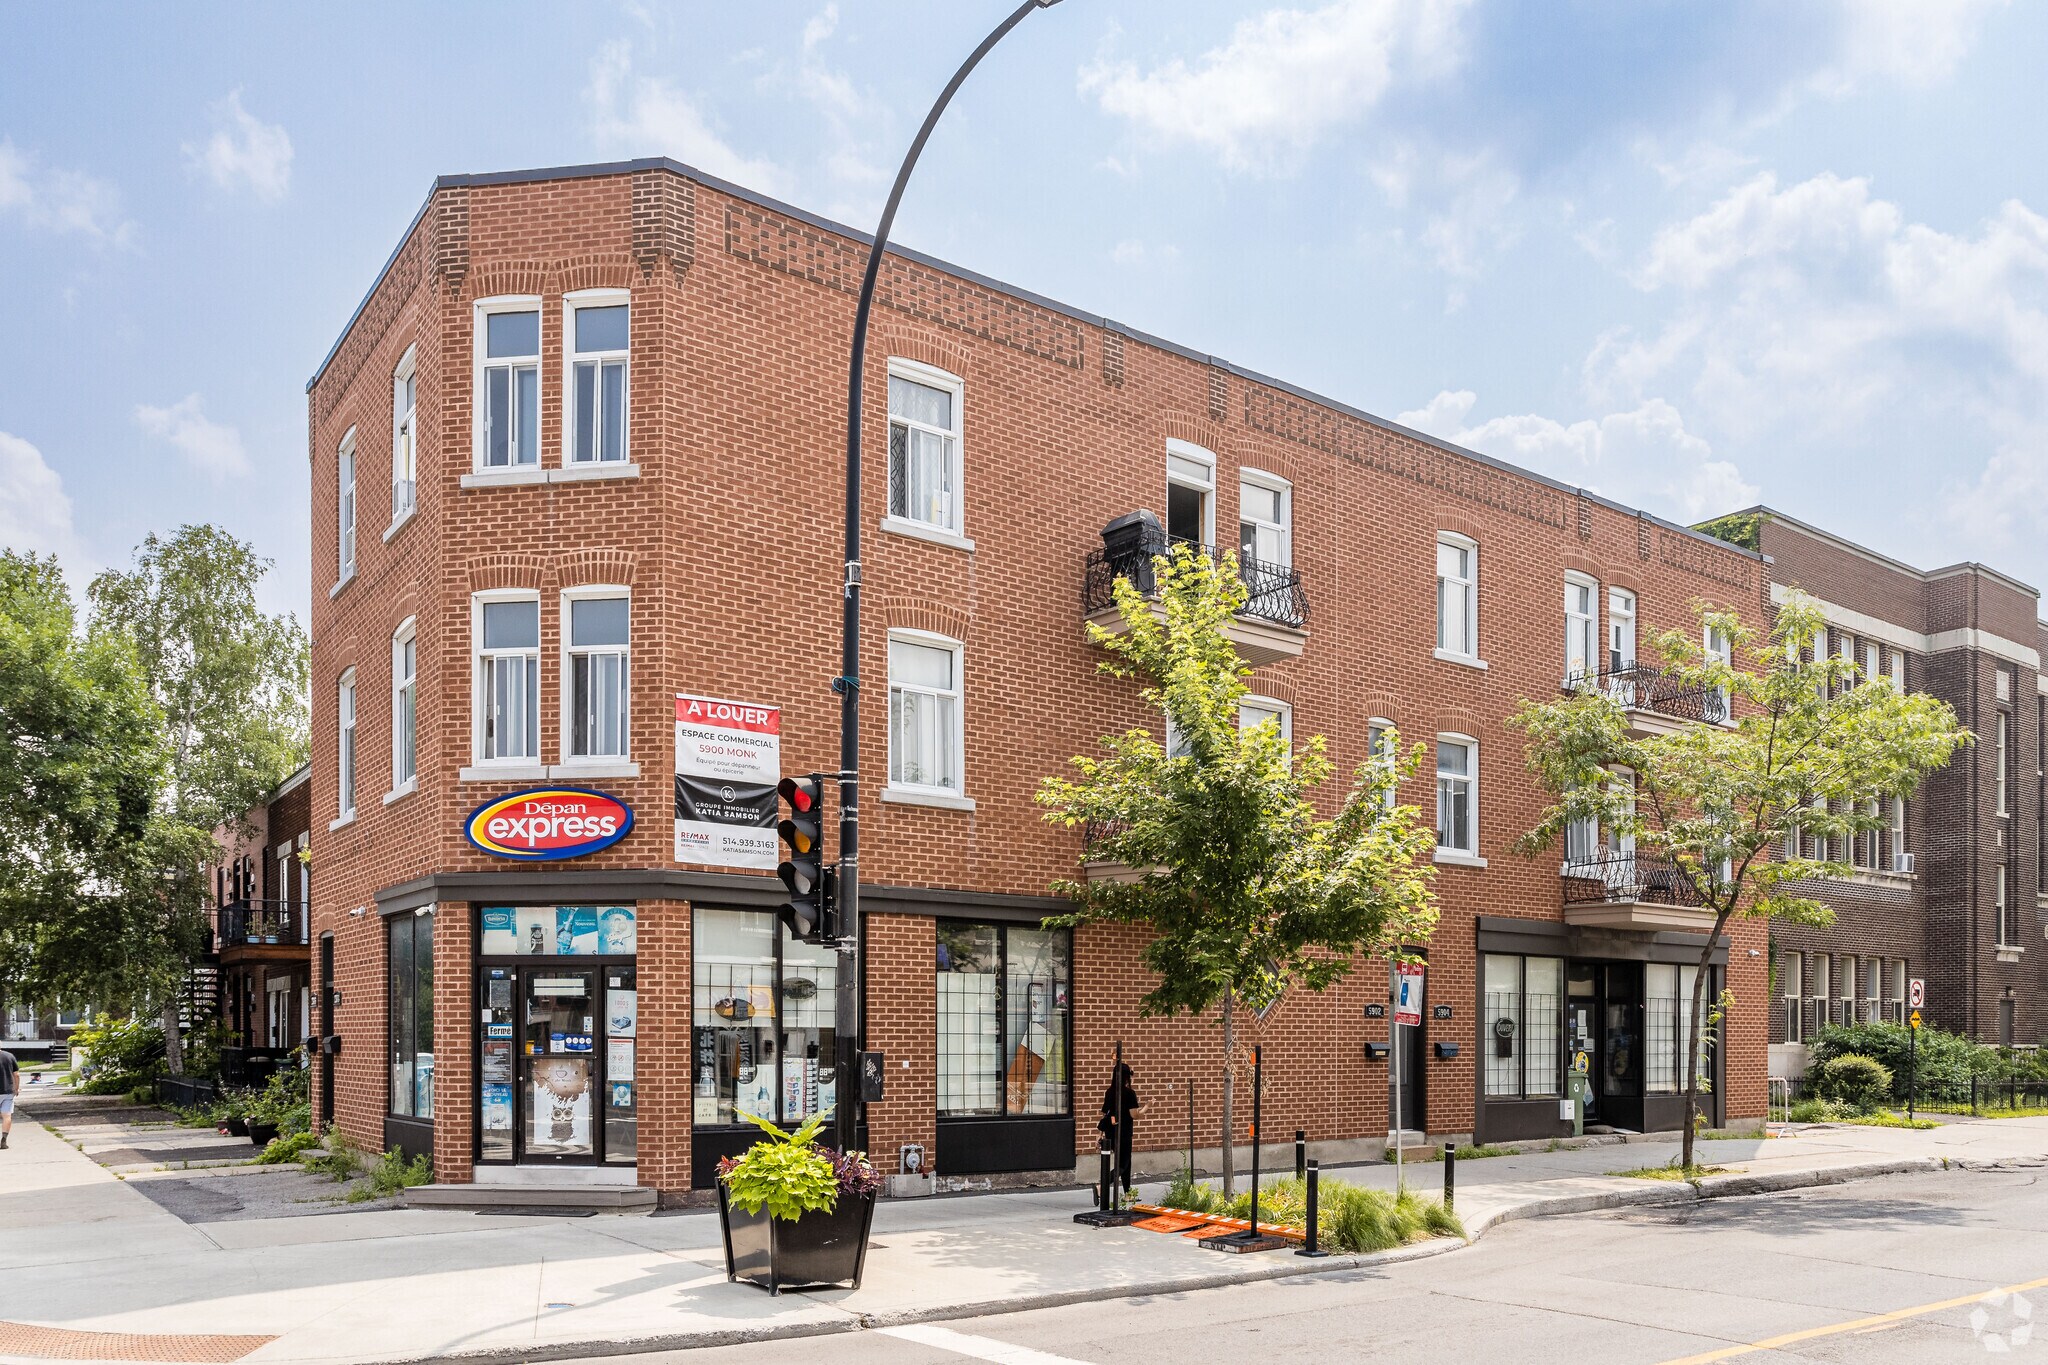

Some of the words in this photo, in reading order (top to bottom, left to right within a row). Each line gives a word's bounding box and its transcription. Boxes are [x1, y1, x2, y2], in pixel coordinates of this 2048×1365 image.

[706, 702, 769, 726] LOUER
[681, 729, 715, 741] ESPACE
[717, 734, 774, 749] COMMERCIAL
[699, 744, 724, 755] 5900
[726, 747, 758, 760] MONK
[722, 767, 745, 776] épicerie
[724, 789, 732, 799] K
[524, 802, 587, 818] Dépan
[695, 801, 722, 810] GROUPE
[723, 804, 760, 814] IMMOBILIER
[695, 807, 722, 817] KATIA
[724, 811, 760, 821] SAMSON
[488, 815, 617, 847] express
[680, 831, 710, 841] RE/MAX
[722, 837, 775, 849] 514.939.3163
[722, 847, 775, 856] KATIASAMSON.COM
[1368, 1007, 1382, 1016] 5902
[1437, 1008, 1450, 1017] 5904
[489, 1025, 512, 1035] Fermé
